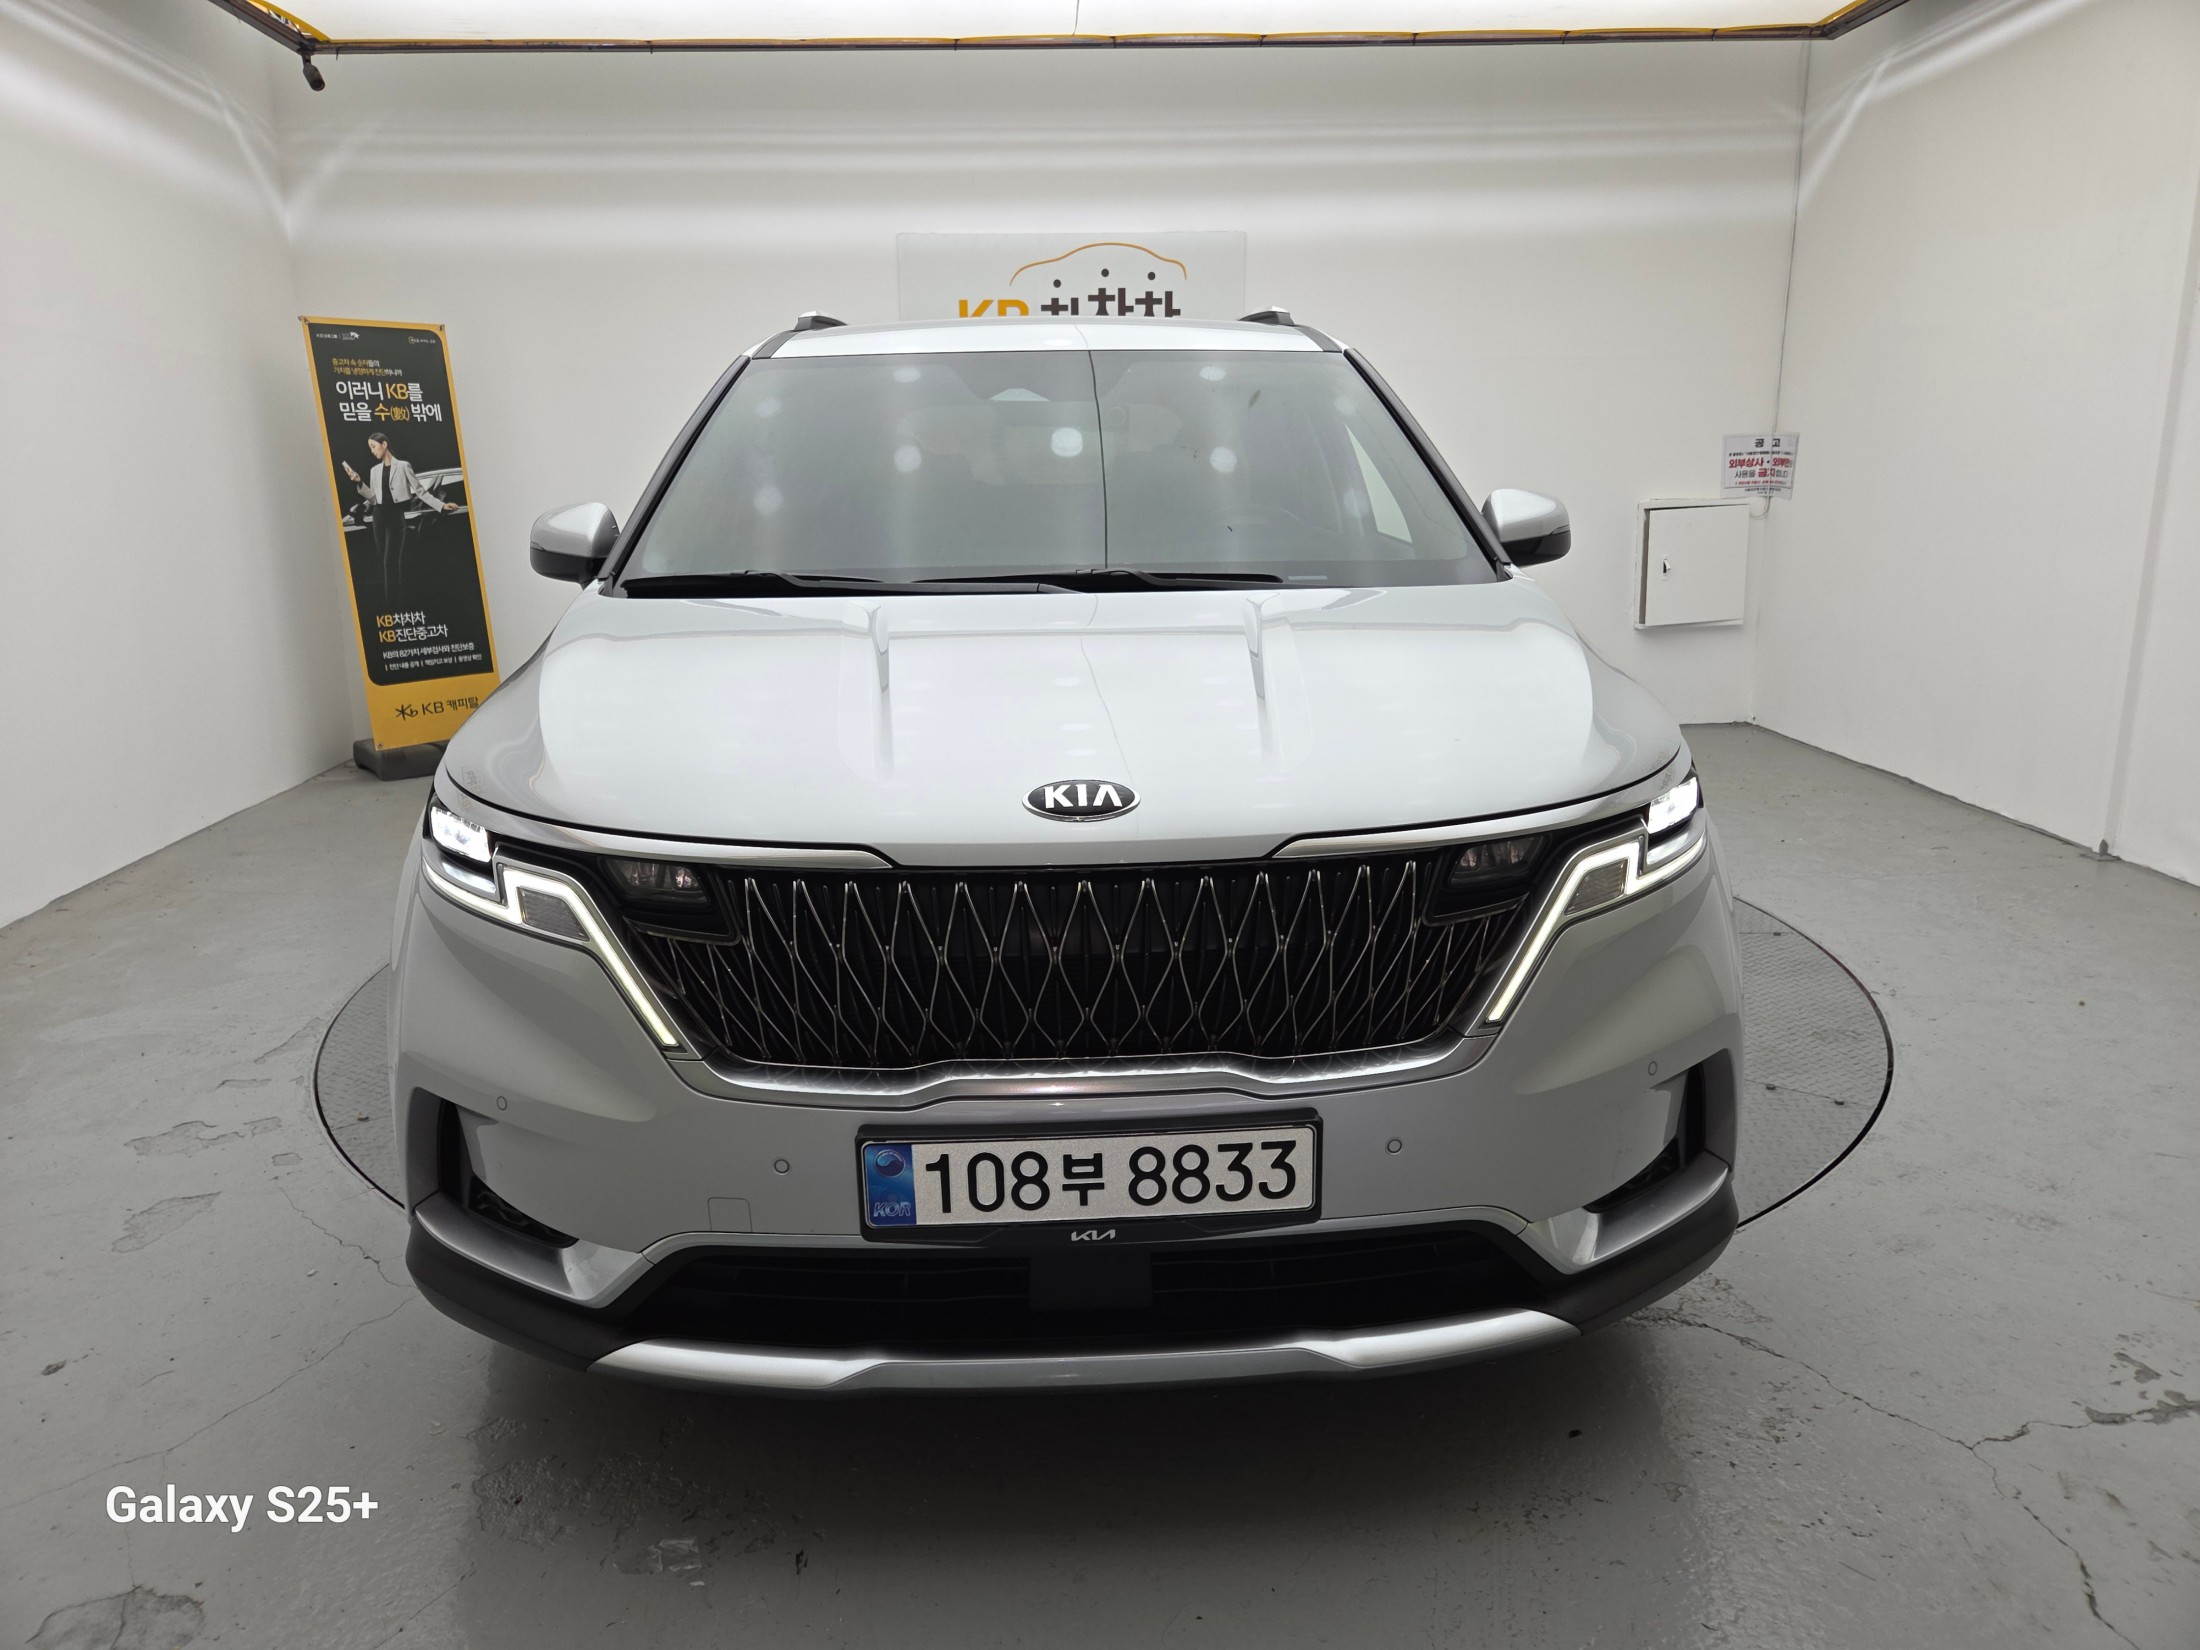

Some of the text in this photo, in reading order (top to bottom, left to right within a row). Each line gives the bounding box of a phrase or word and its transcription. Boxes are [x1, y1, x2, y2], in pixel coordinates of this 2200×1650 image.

[336, 381, 423, 402] 이러니 KB를
[339, 402, 372, 421] 믿을
[411, 403, 442, 422] 밖에
[1729, 457, 1764, 468] 외부상사
[376, 611, 426, 628] KB차차차
[379, 624, 448, 643] KB진단중고차
[422, 702, 445, 715] KB
[1044, 784, 1123, 809] KIA
[925, 1140, 1297, 1214] 108부 8833
[873, 1202, 912, 1217] KOR
